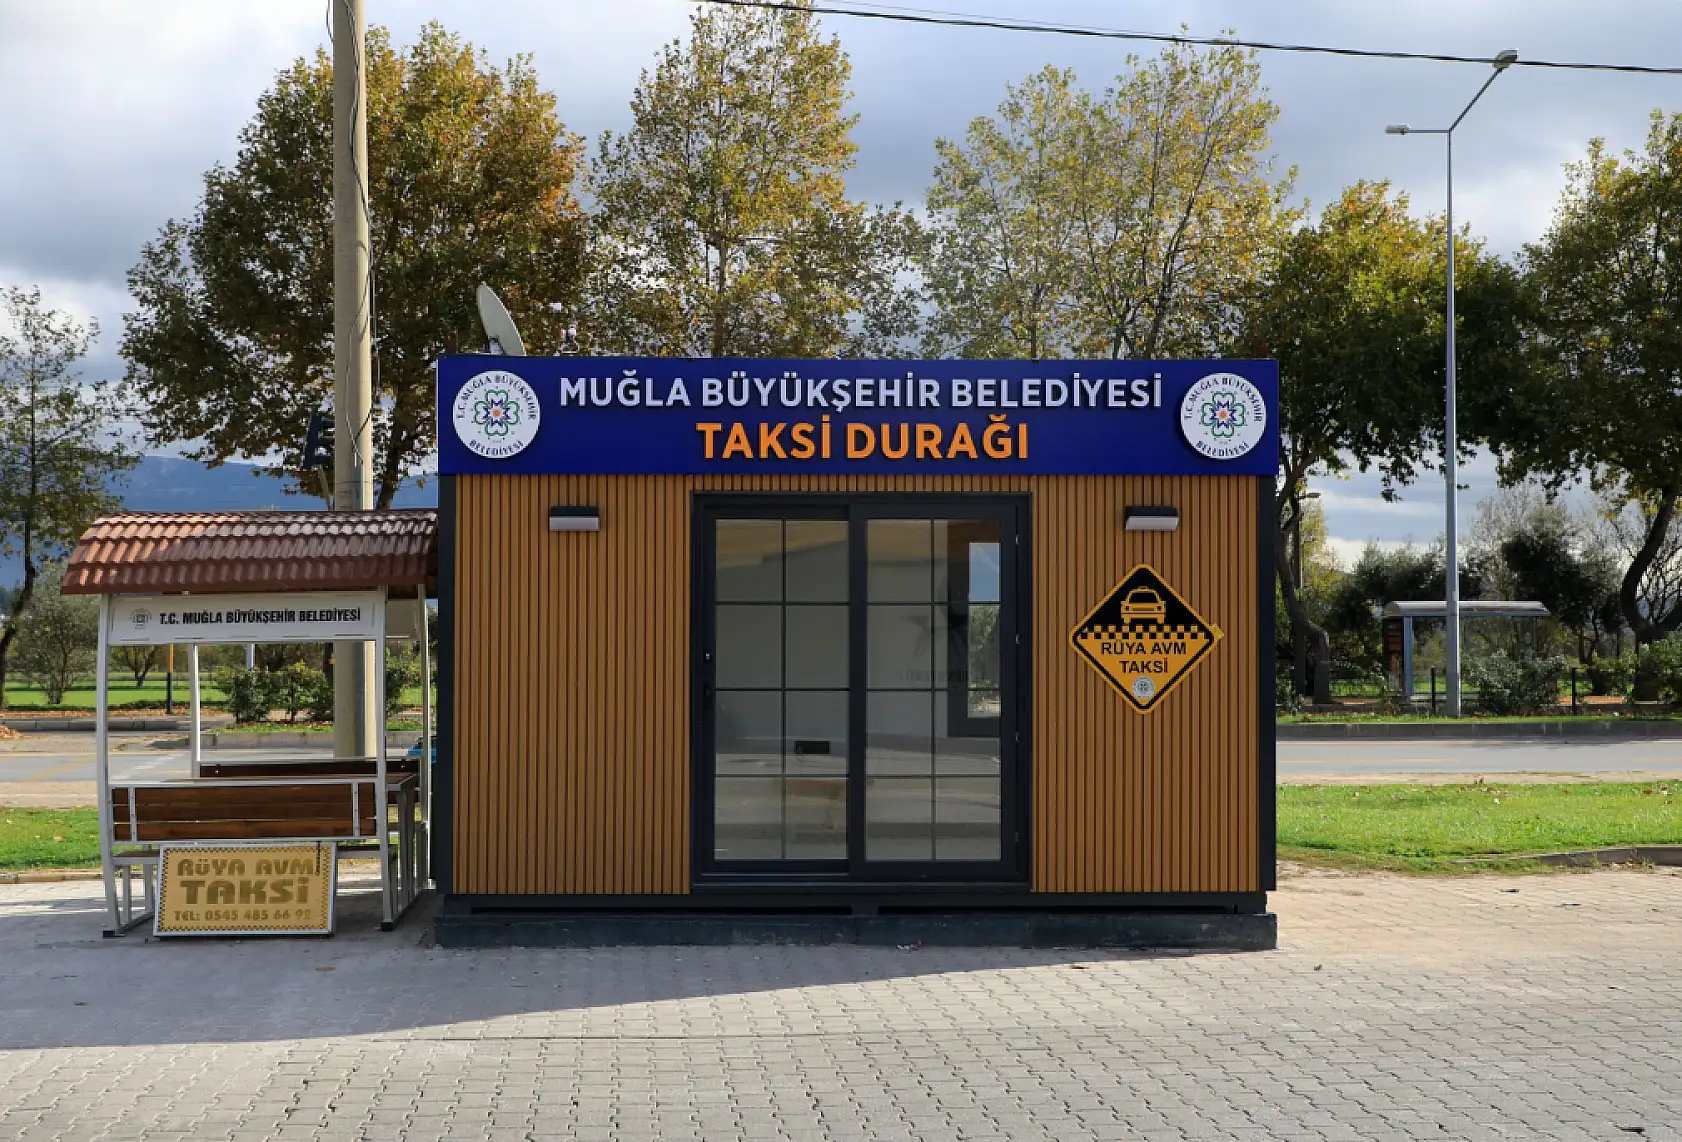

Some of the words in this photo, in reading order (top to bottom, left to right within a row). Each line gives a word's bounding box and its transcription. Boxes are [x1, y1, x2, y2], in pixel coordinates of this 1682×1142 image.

[560, 369, 691, 407] MUĞLA
[702, 370, 941, 412] BÜYÜKŞEHİR
[951, 372, 1162, 407] BELEDİYESİ
[696, 414, 831, 459] TAKSİ
[846, 413, 1028, 459] DURAĞI
[159, 612, 180, 625] T.C.
[182, 609, 222, 624] MUĞLA
[226, 607, 296, 624] BÜYÜKŞEHİR
[299, 606, 361, 622] BELEDİYESİ
[1101, 639, 1146, 655] RÜYA
[1151, 641, 1187, 655] AVM
[1119, 657, 1168, 673] TAKSİ
[255, 858, 314, 875] AVM
